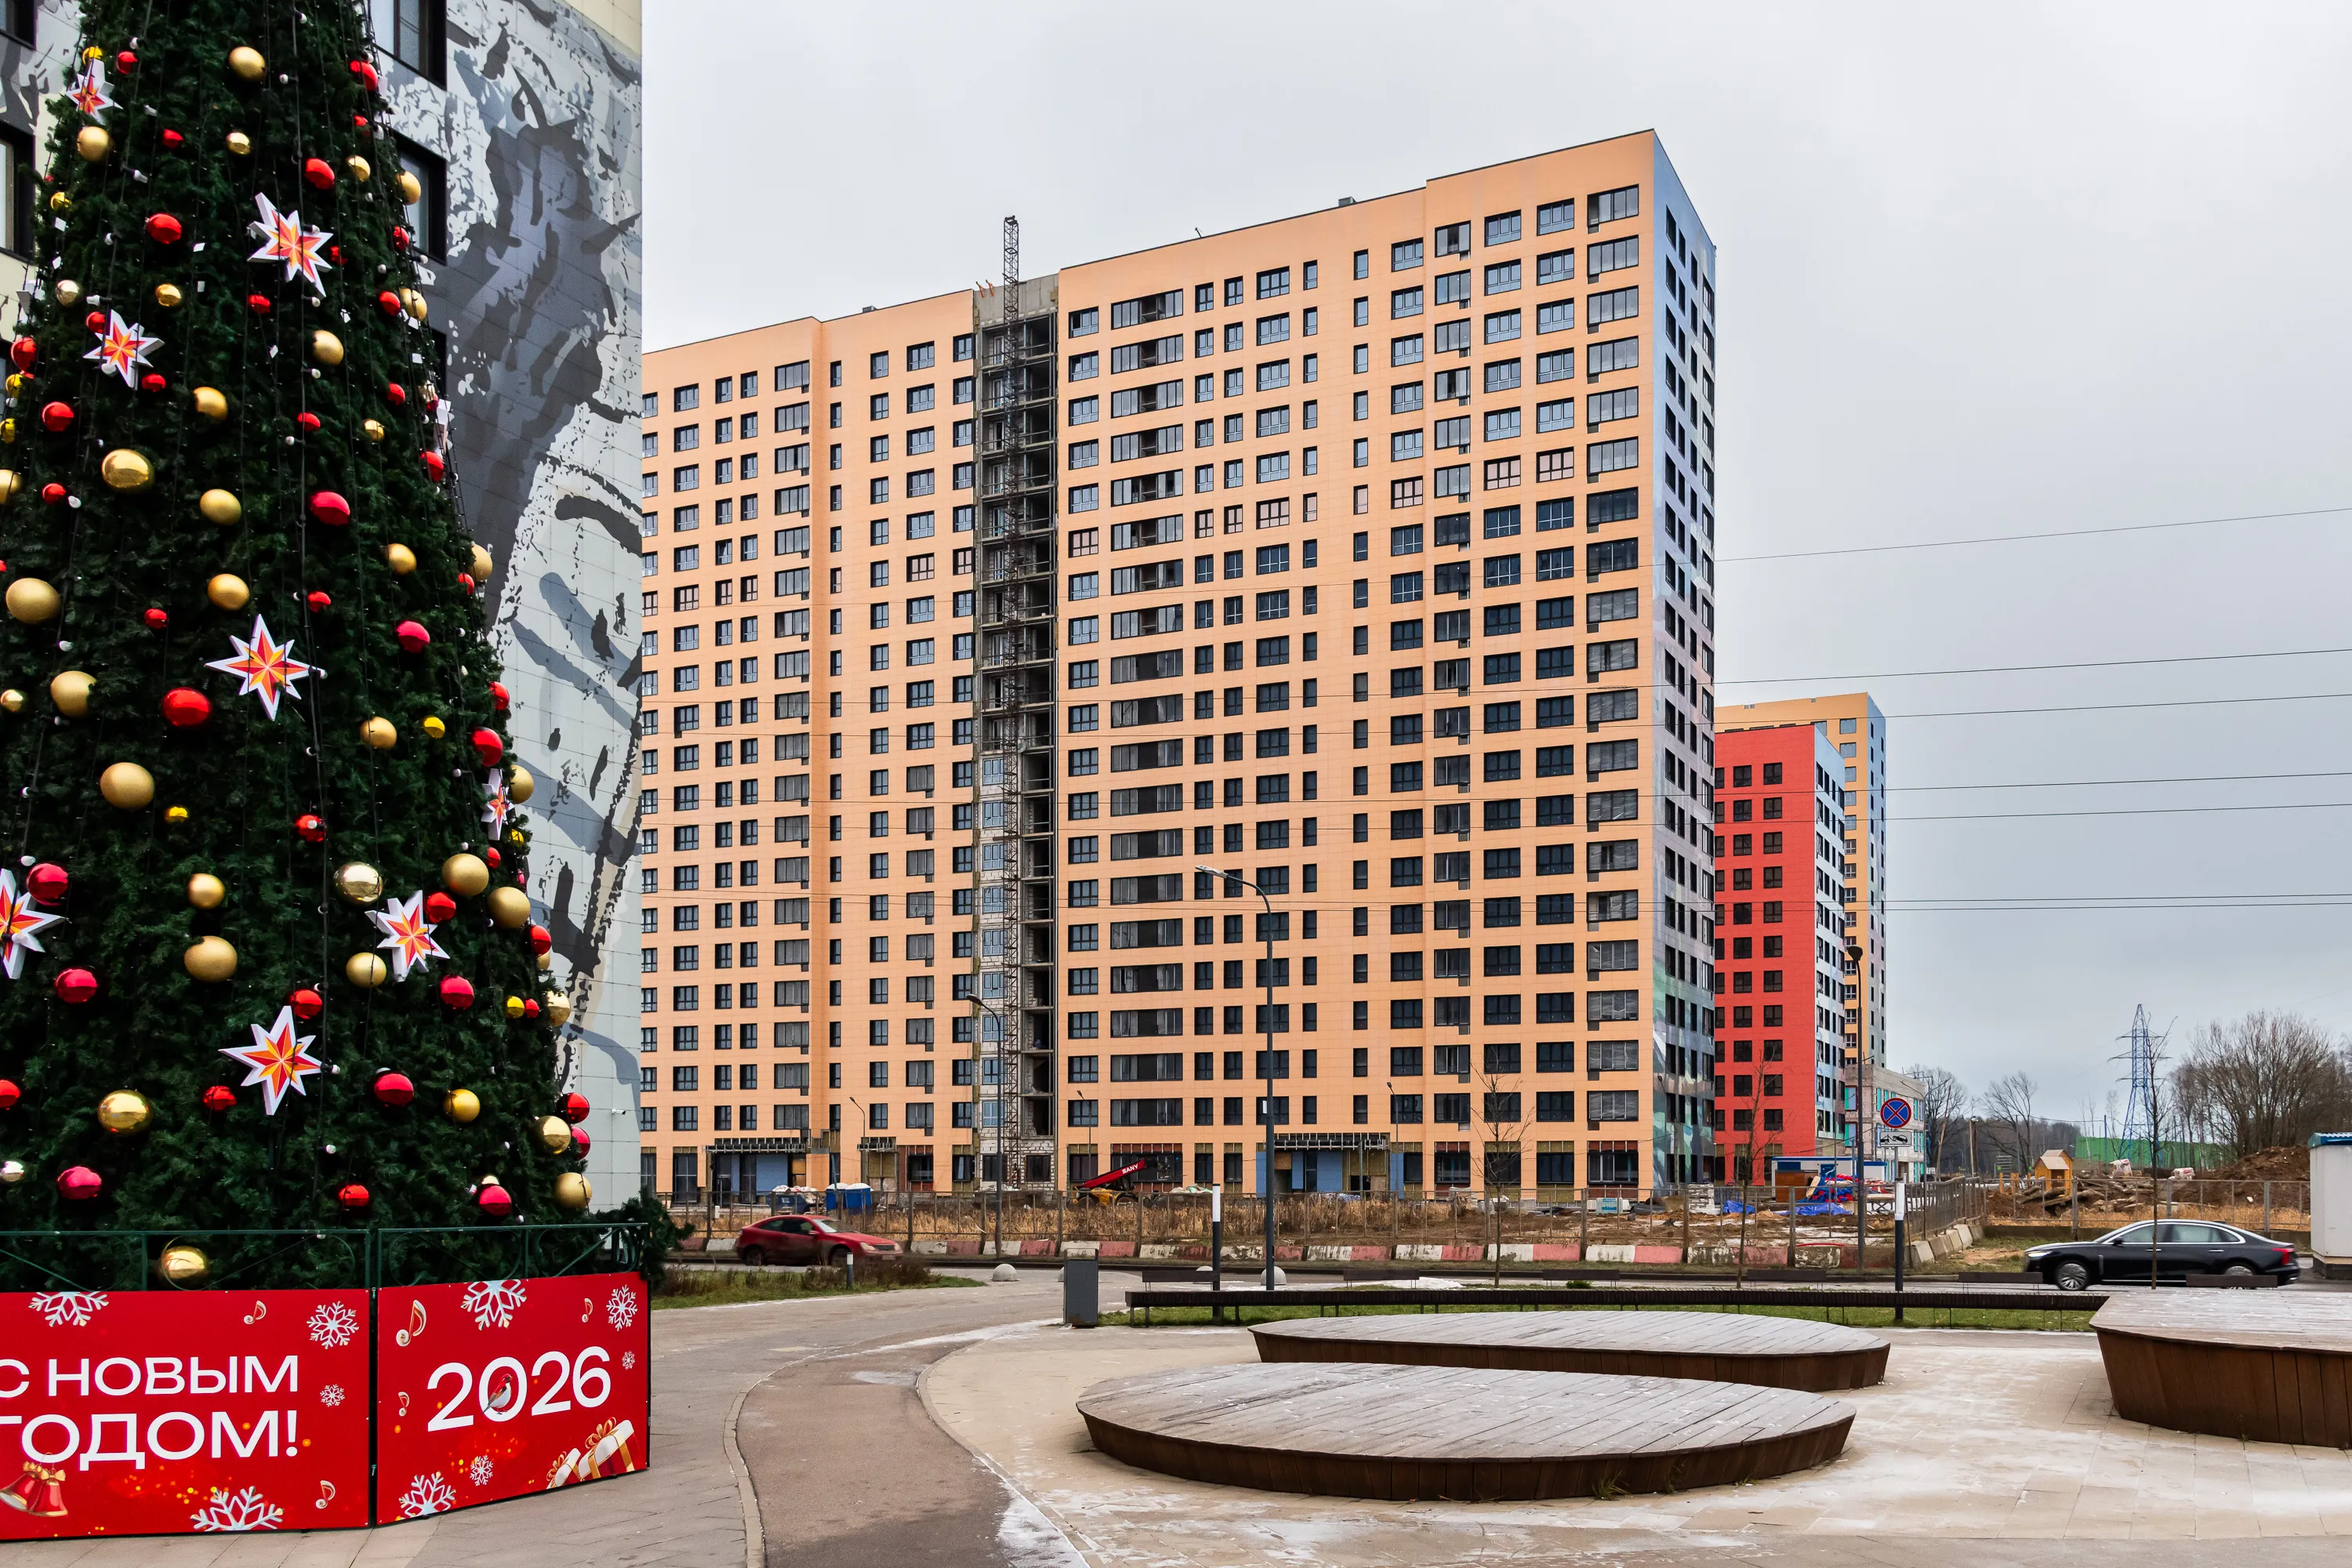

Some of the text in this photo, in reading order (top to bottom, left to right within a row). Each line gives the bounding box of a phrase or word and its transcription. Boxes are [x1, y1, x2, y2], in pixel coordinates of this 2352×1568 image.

[1122, 1163, 1138, 1174] SANY
[0, 1356, 298, 1398] С НОВЫМ
[427, 1345, 612, 1432] 2026
